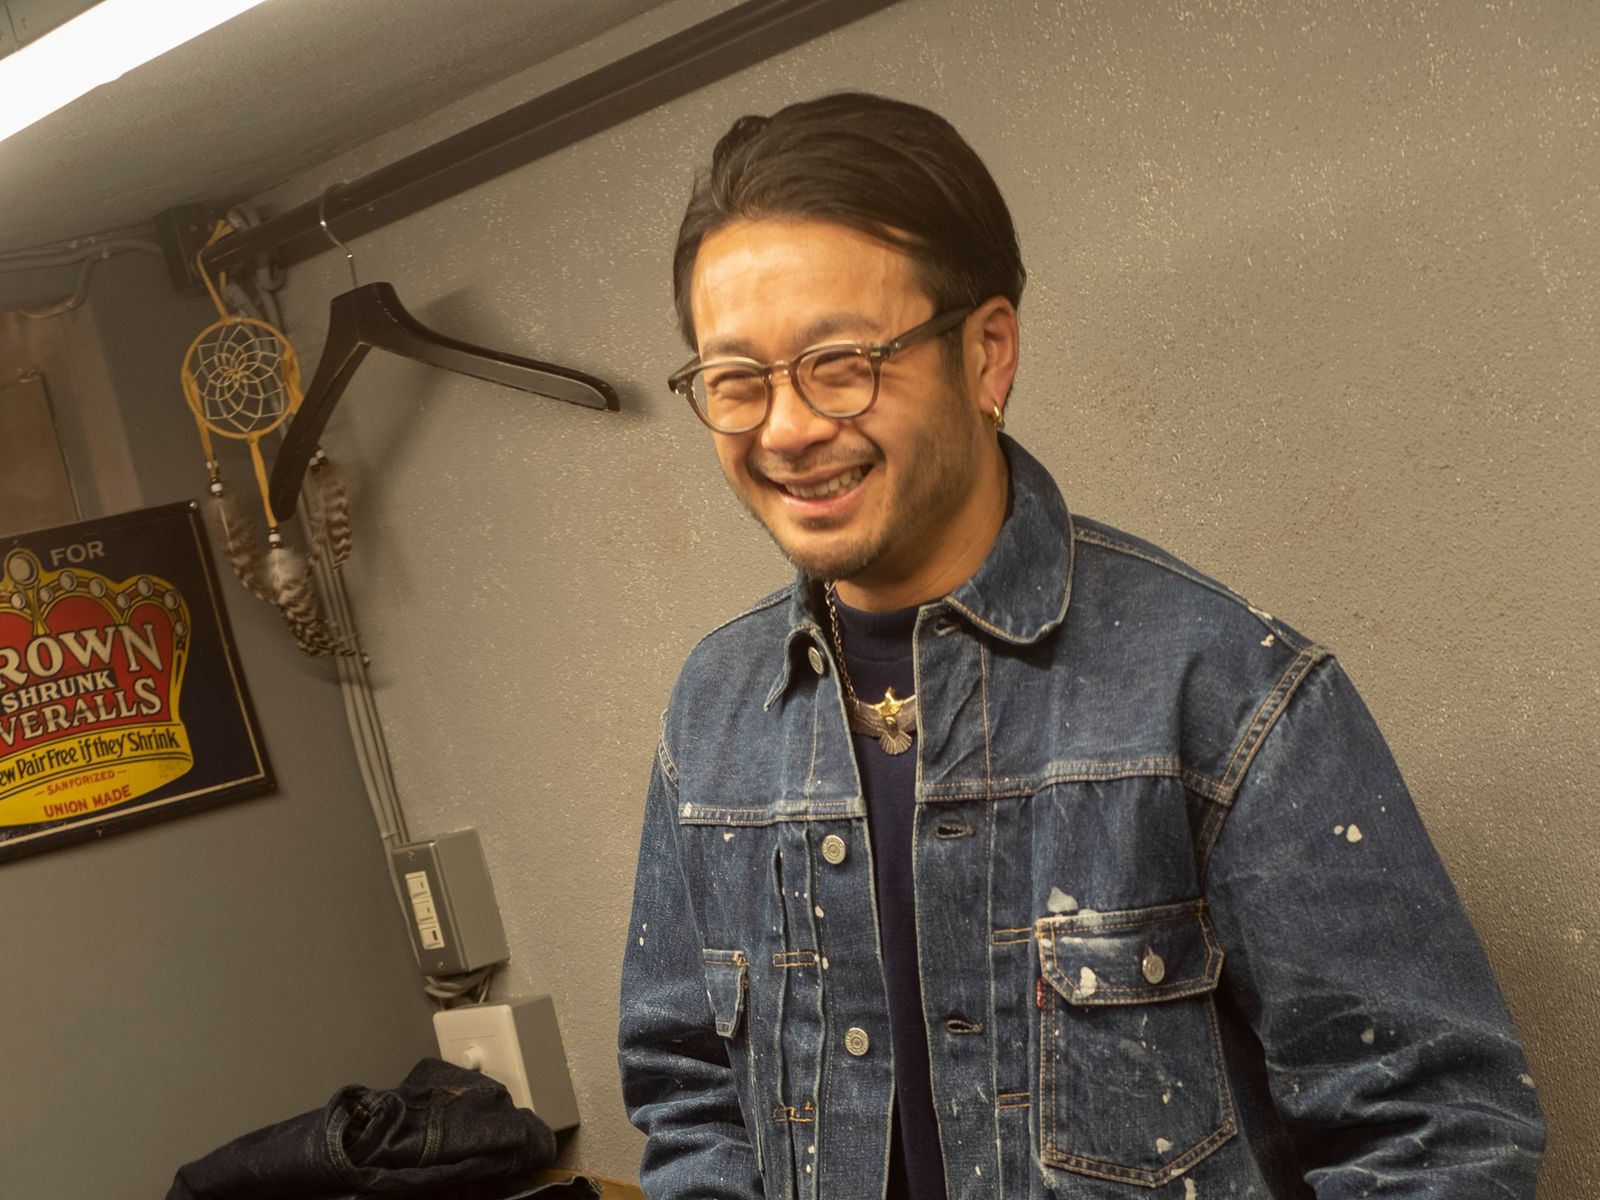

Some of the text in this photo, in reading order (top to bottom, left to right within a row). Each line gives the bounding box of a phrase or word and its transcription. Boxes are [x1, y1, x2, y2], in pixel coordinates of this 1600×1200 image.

[50, 540, 106, 567] FOR
[0, 677, 162, 746] VERALLS
[2, 670, 116, 714] SHRUNK
[16, 753, 46, 779] Pair
[46, 748, 79, 769] Free
[78, 739, 93, 763] if
[92, 734, 126, 758] they
[126, 727, 181, 753] Shrink
[43, 784, 132, 818] UNION MADE
[46, 769, 116, 796] SANFORIZED
